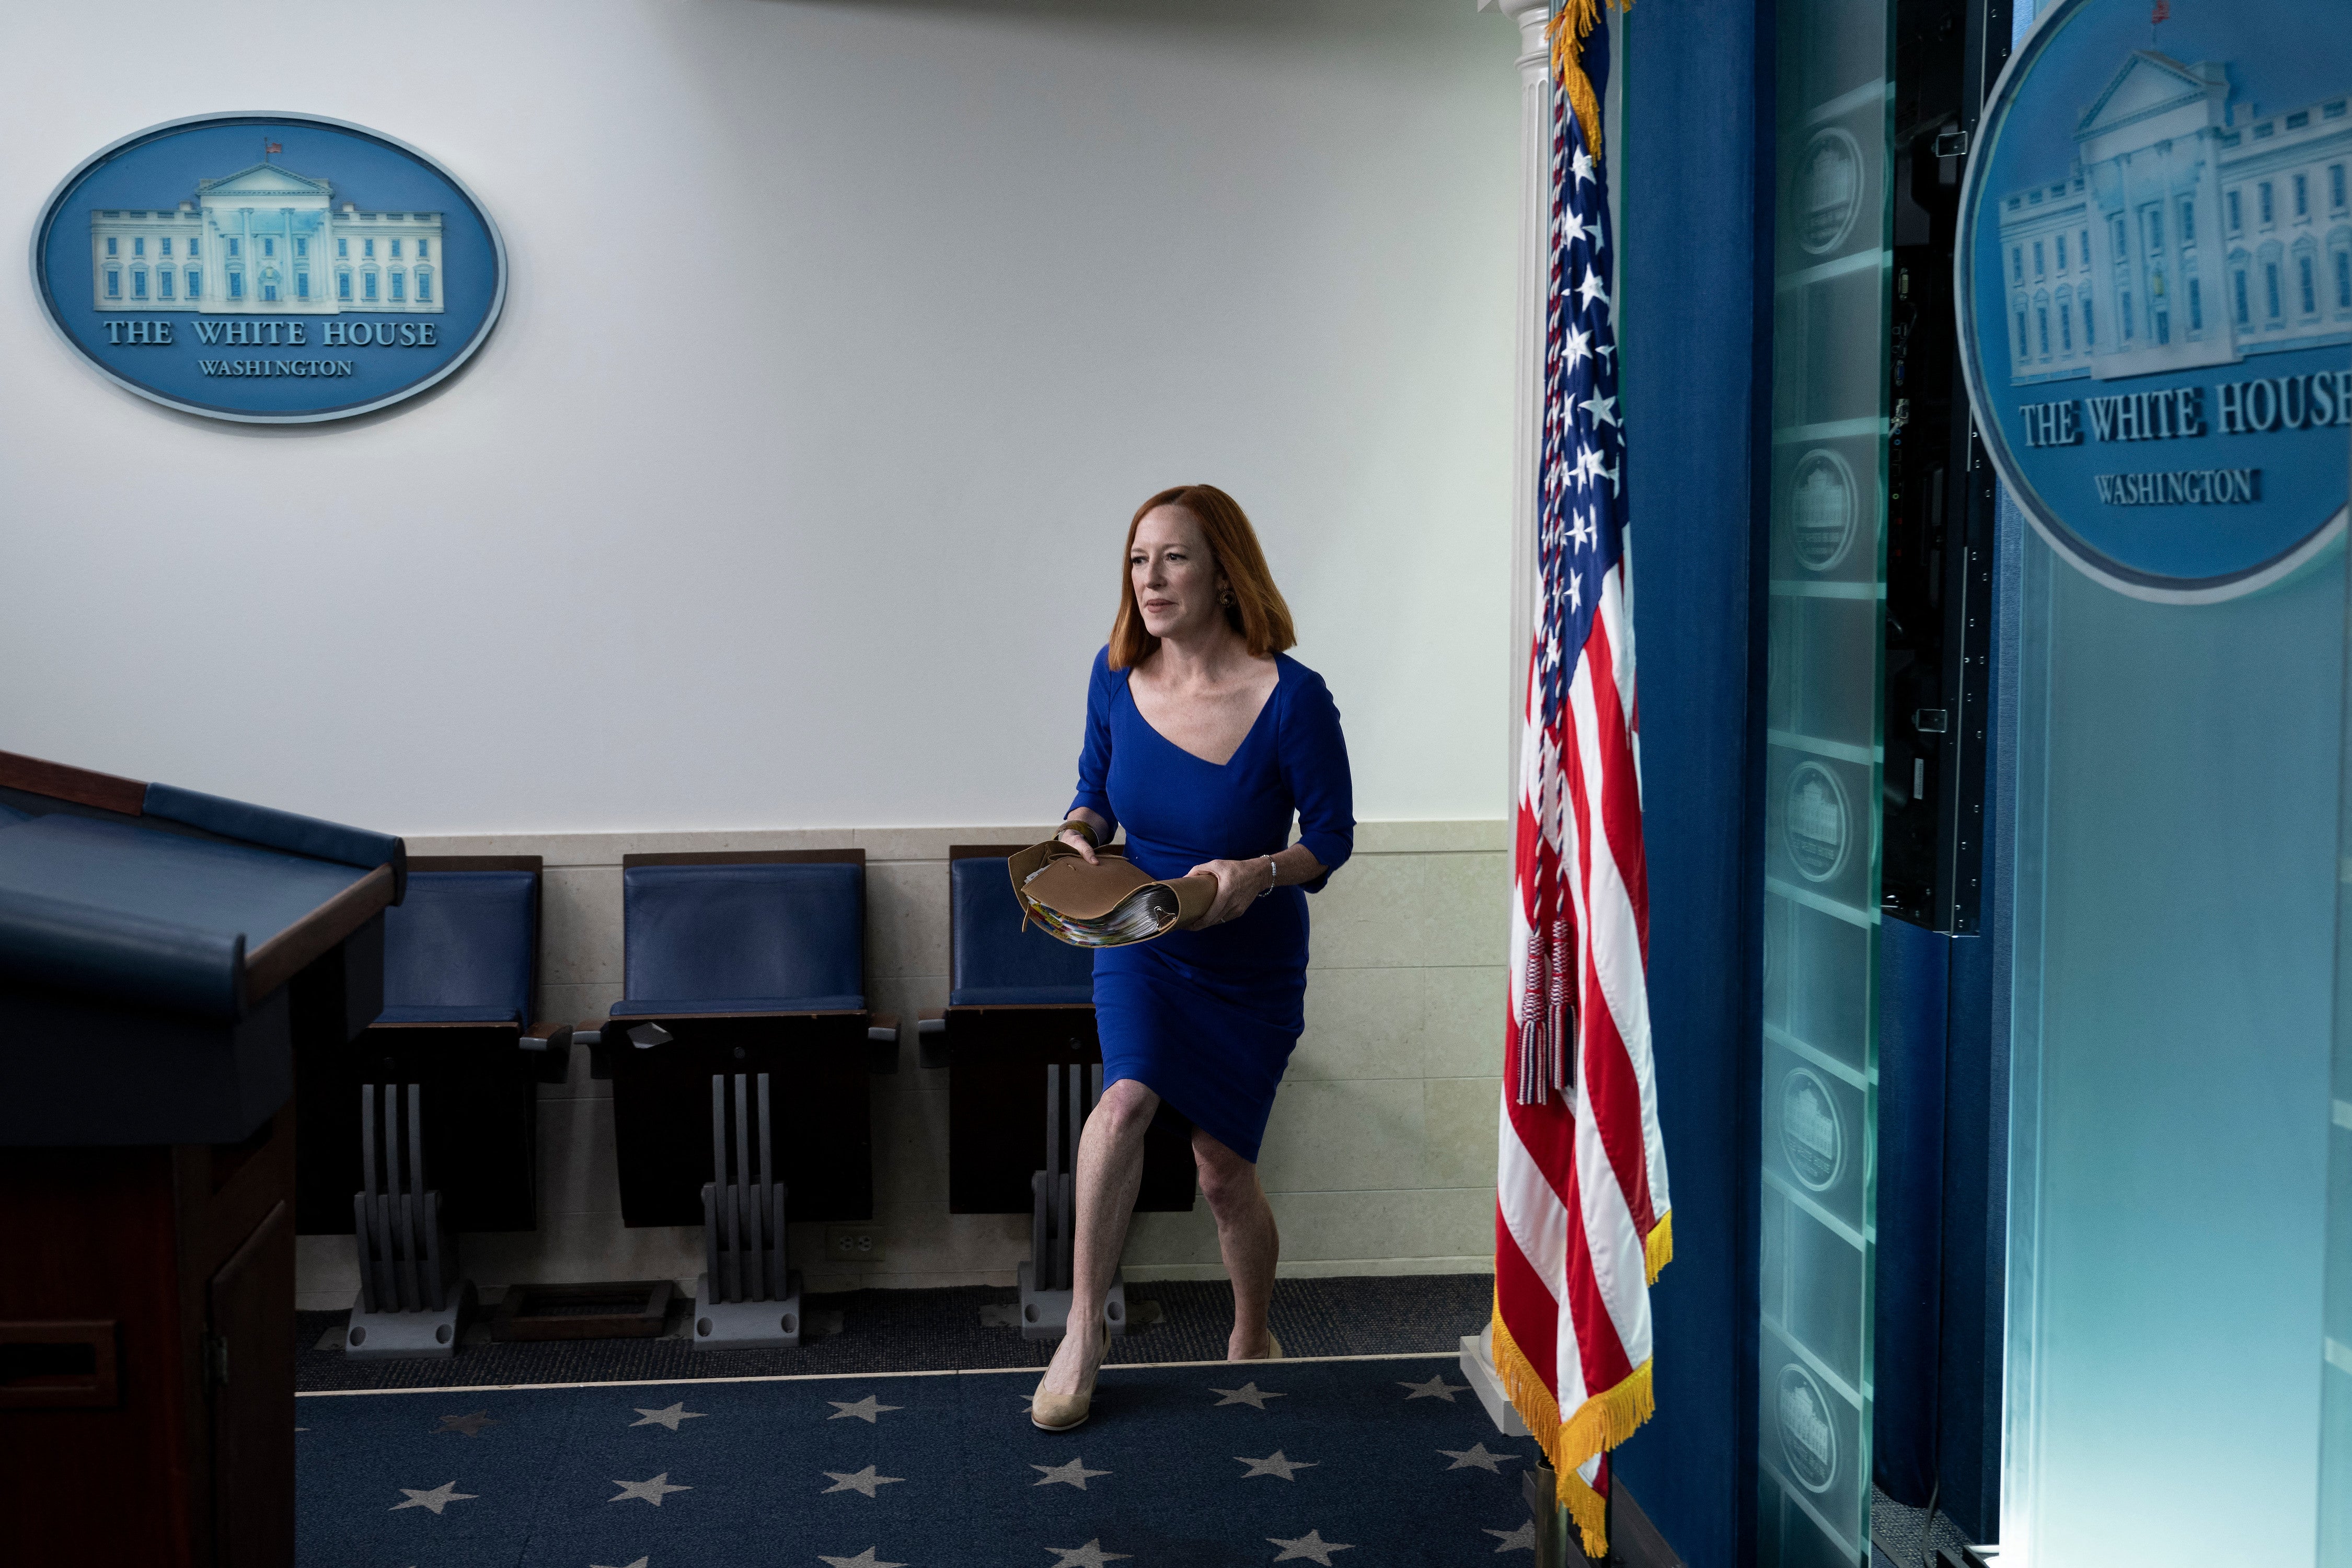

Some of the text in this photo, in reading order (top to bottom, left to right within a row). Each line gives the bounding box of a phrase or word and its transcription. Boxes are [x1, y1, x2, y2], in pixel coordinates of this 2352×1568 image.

[104, 321, 437, 346] THE WHITE HOUSE
[198, 360, 353, 376] WASHINGTON
[2019, 370, 2352, 446] THE WHITE HOUSE
[2094, 469, 2253, 504] WASHINGTON
